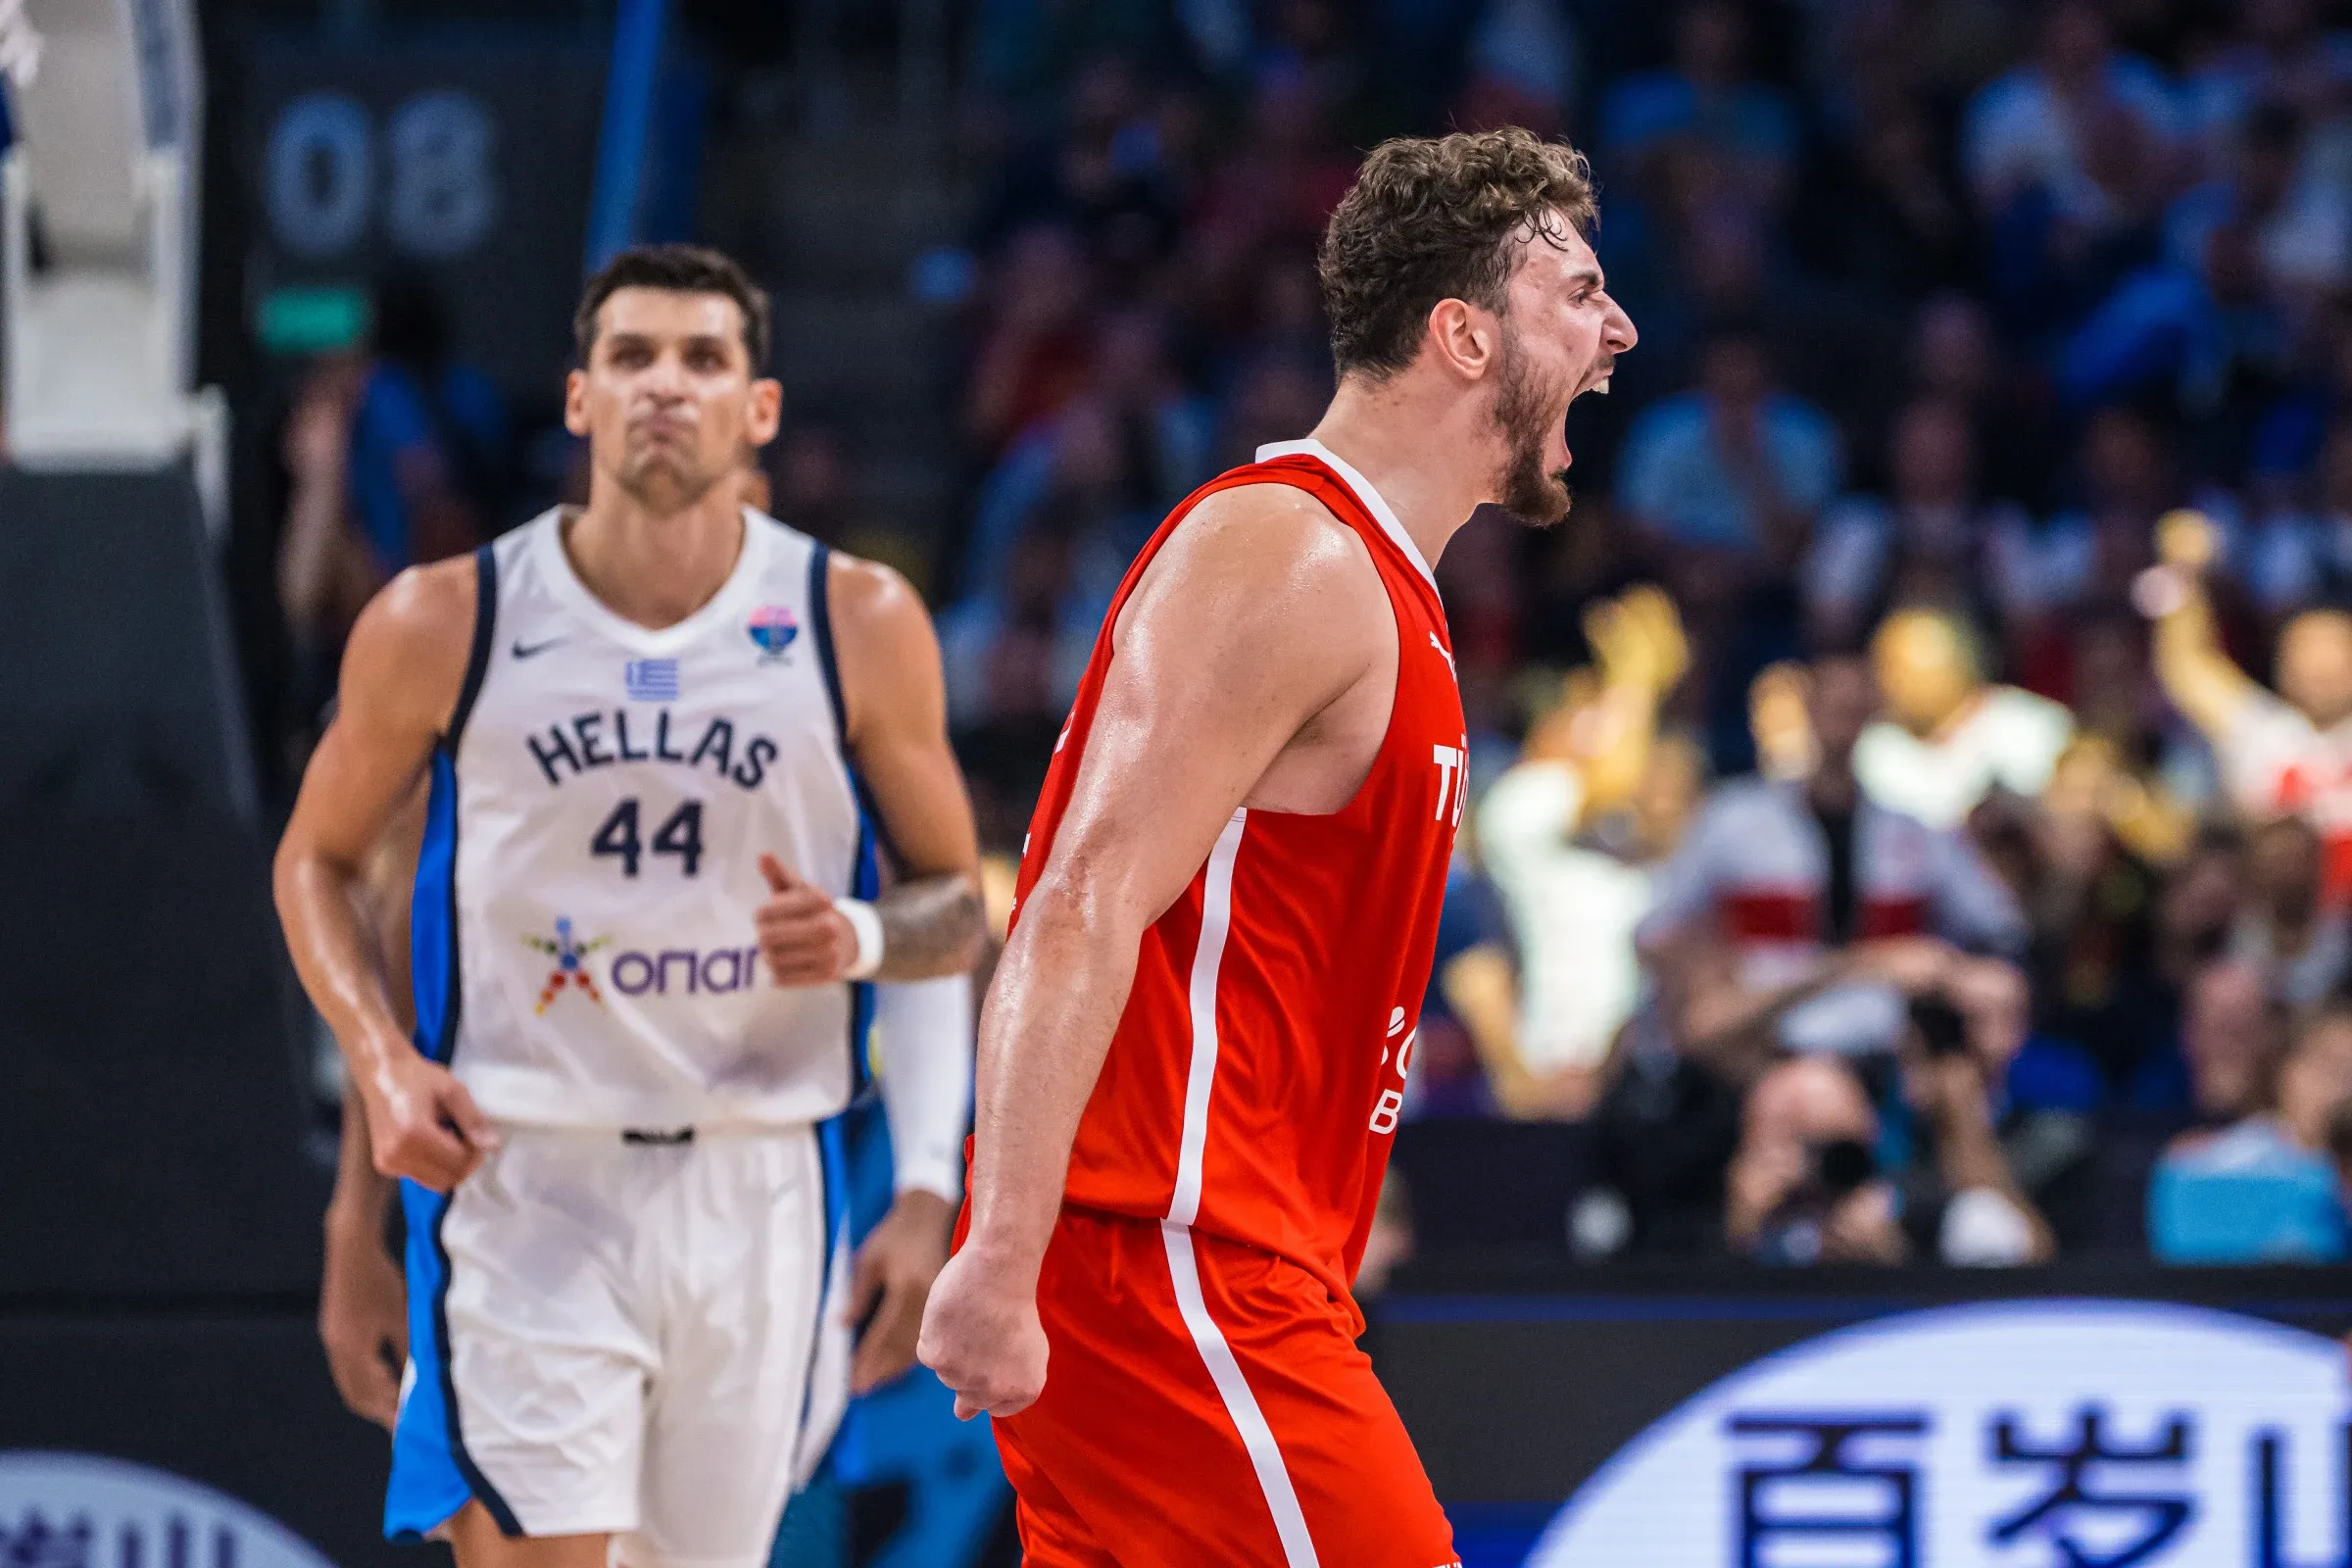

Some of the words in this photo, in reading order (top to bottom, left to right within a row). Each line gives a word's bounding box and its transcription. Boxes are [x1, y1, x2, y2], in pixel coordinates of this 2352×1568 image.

[265, 91, 496, 257] 08
[526, 709, 779, 792] HELLAS
[590, 798, 704, 878] 44
